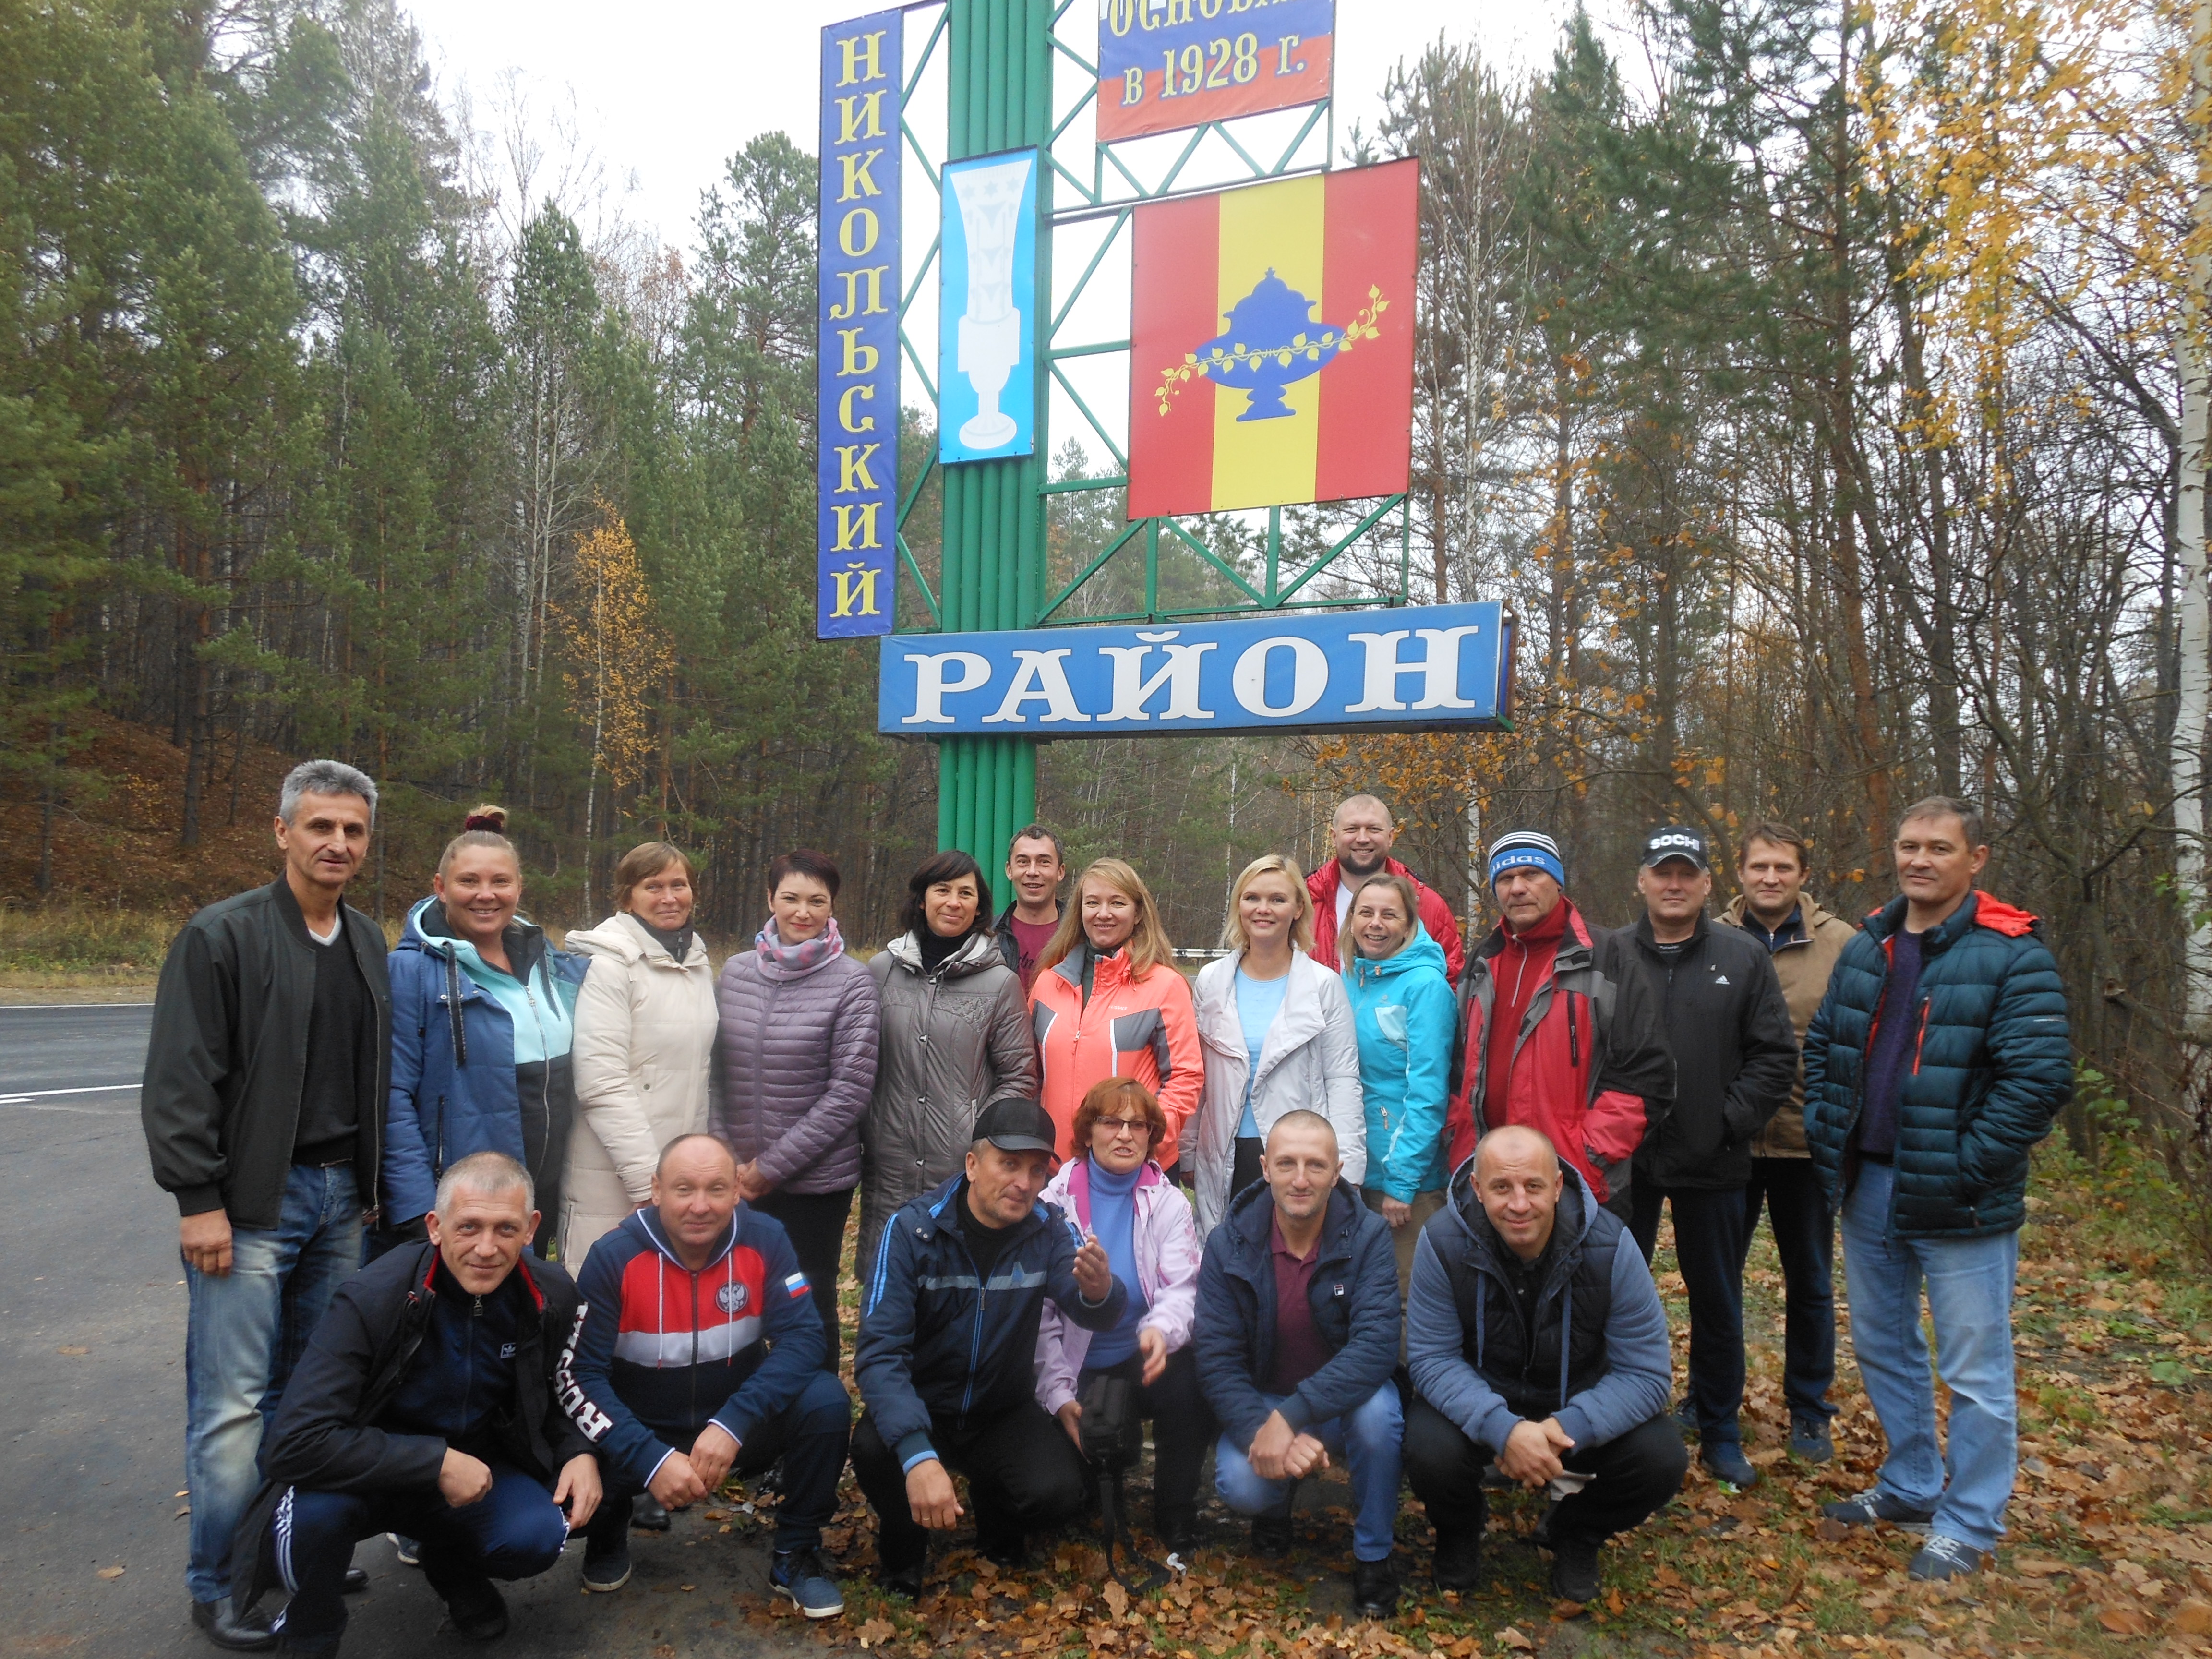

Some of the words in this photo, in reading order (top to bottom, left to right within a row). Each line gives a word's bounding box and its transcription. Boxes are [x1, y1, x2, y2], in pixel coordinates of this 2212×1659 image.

[1161, 32, 1258, 98] 1928
[829, 30, 889, 617] НИКОЛЬСКИЙ
[901, 625, 1479, 724] РАЙОН
[1650, 834, 1699, 852] SOCHI
